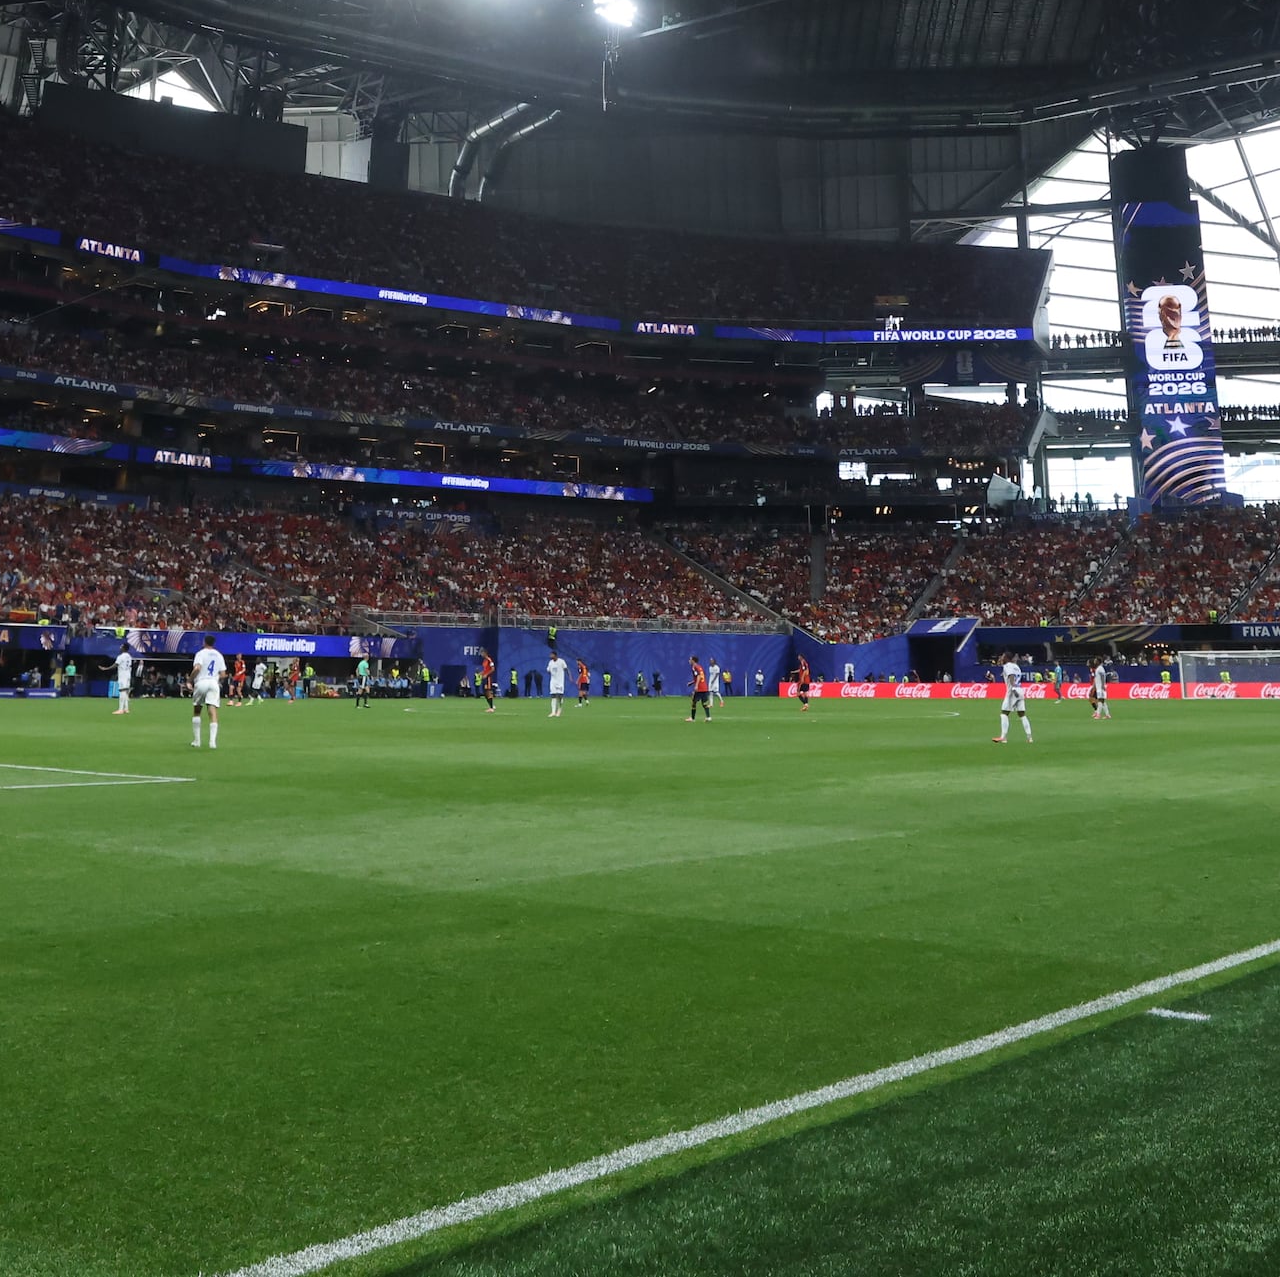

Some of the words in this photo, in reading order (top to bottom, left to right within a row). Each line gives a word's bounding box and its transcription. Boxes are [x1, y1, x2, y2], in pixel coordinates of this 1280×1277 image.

[80, 238, 141, 262] ATLANTA
[379, 289, 428, 306] #FIFAWorldCup
[637, 322, 696, 335] ATLANTA
[873, 331, 900, 341] FIFA
[900, 330, 946, 341] WORLD
[946, 330, 972, 340] CUP
[972, 329, 1018, 340] 2026
[1163, 353, 1188, 362] FIFA
[1148, 373, 1184, 382] WORLD
[1185, 372, 1206, 381] CUP
[54, 375, 118, 393] ATLANTA
[1148, 382, 1208, 396] 2026
[1144, 402, 1216, 415] ATLANTA
[434, 422, 492, 434] ATLANTA
[623, 438, 640, 447] FIFA
[640, 440, 665, 449] WORLD
[665, 442, 682, 450] CUP
[839, 448, 898, 456] ATLANTA
[154, 450, 212, 469] ATLANTA
[442, 476, 490, 490] #FIFAWorldCup
[1243, 625, 1271, 638] FIFA
[255, 638, 317, 655] #FIFAWorldCup
[207, 659, 216, 677] 4
